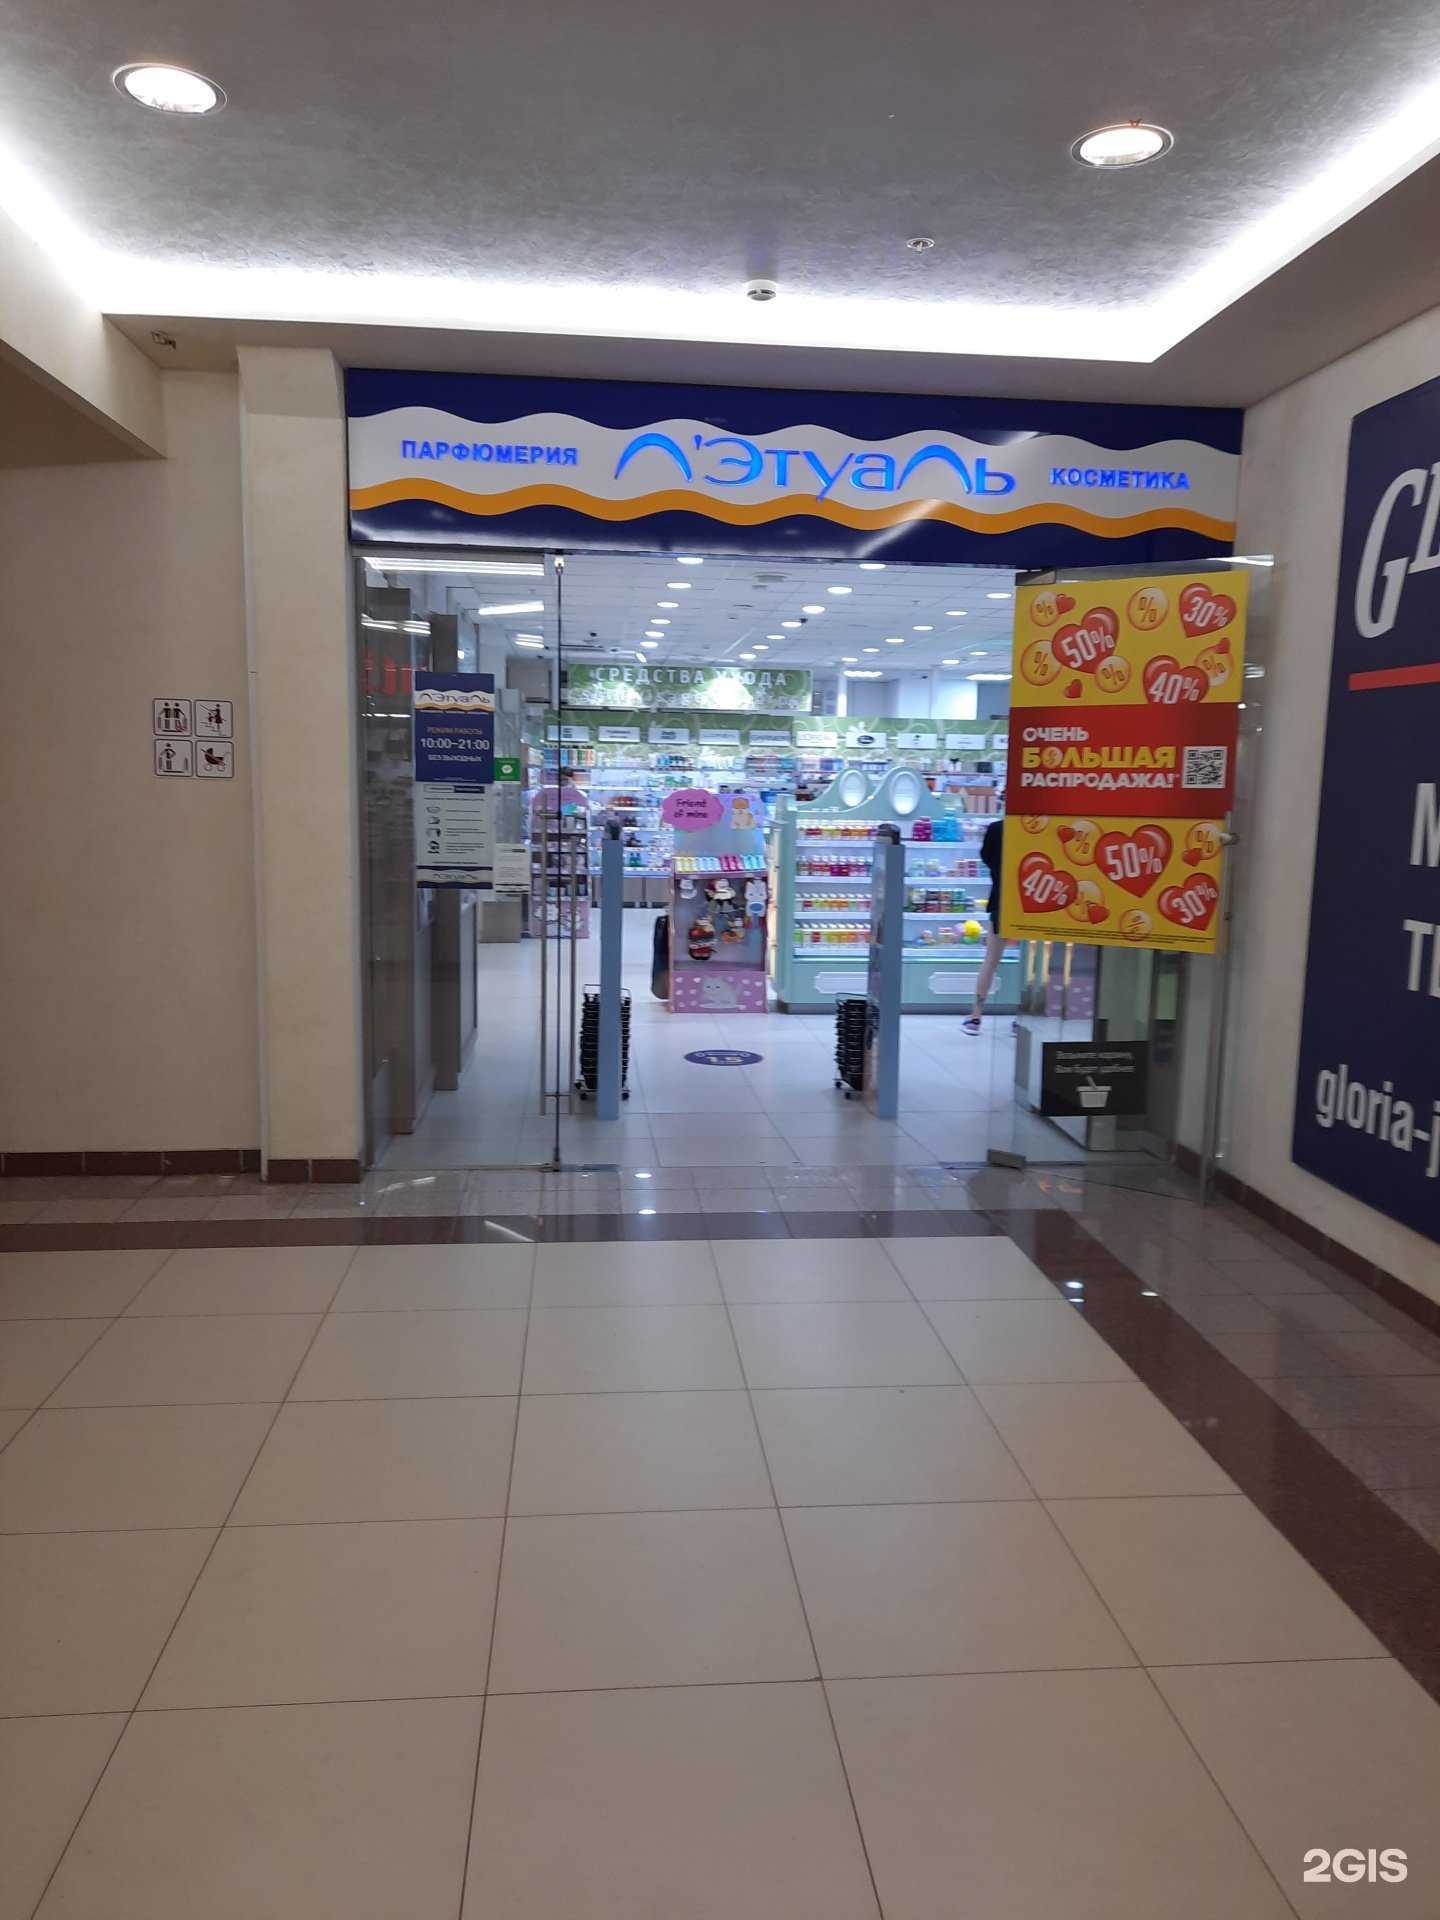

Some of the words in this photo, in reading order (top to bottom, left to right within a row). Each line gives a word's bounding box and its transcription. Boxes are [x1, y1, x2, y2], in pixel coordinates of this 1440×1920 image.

[401, 439, 579, 466] ПАРФЮМЕРИЯ
[1049, 467, 1191, 490] КОСМЕТИКА
[1184, 597, 1228, 627] 30%
[1060, 626, 1115, 668] 50%
[595, 667, 704, 685] СРЕДСТВА
[1149, 671, 1199, 704] 40%
[1023, 727, 1089, 742] ОЧЕНЬ
[1022, 746, 1177, 769] БОЛЬШАЯ
[1104, 842, 1163, 881] 50%
[1023, 869, 1068, 905] 40%
[1171, 882, 1218, 924] 30%
